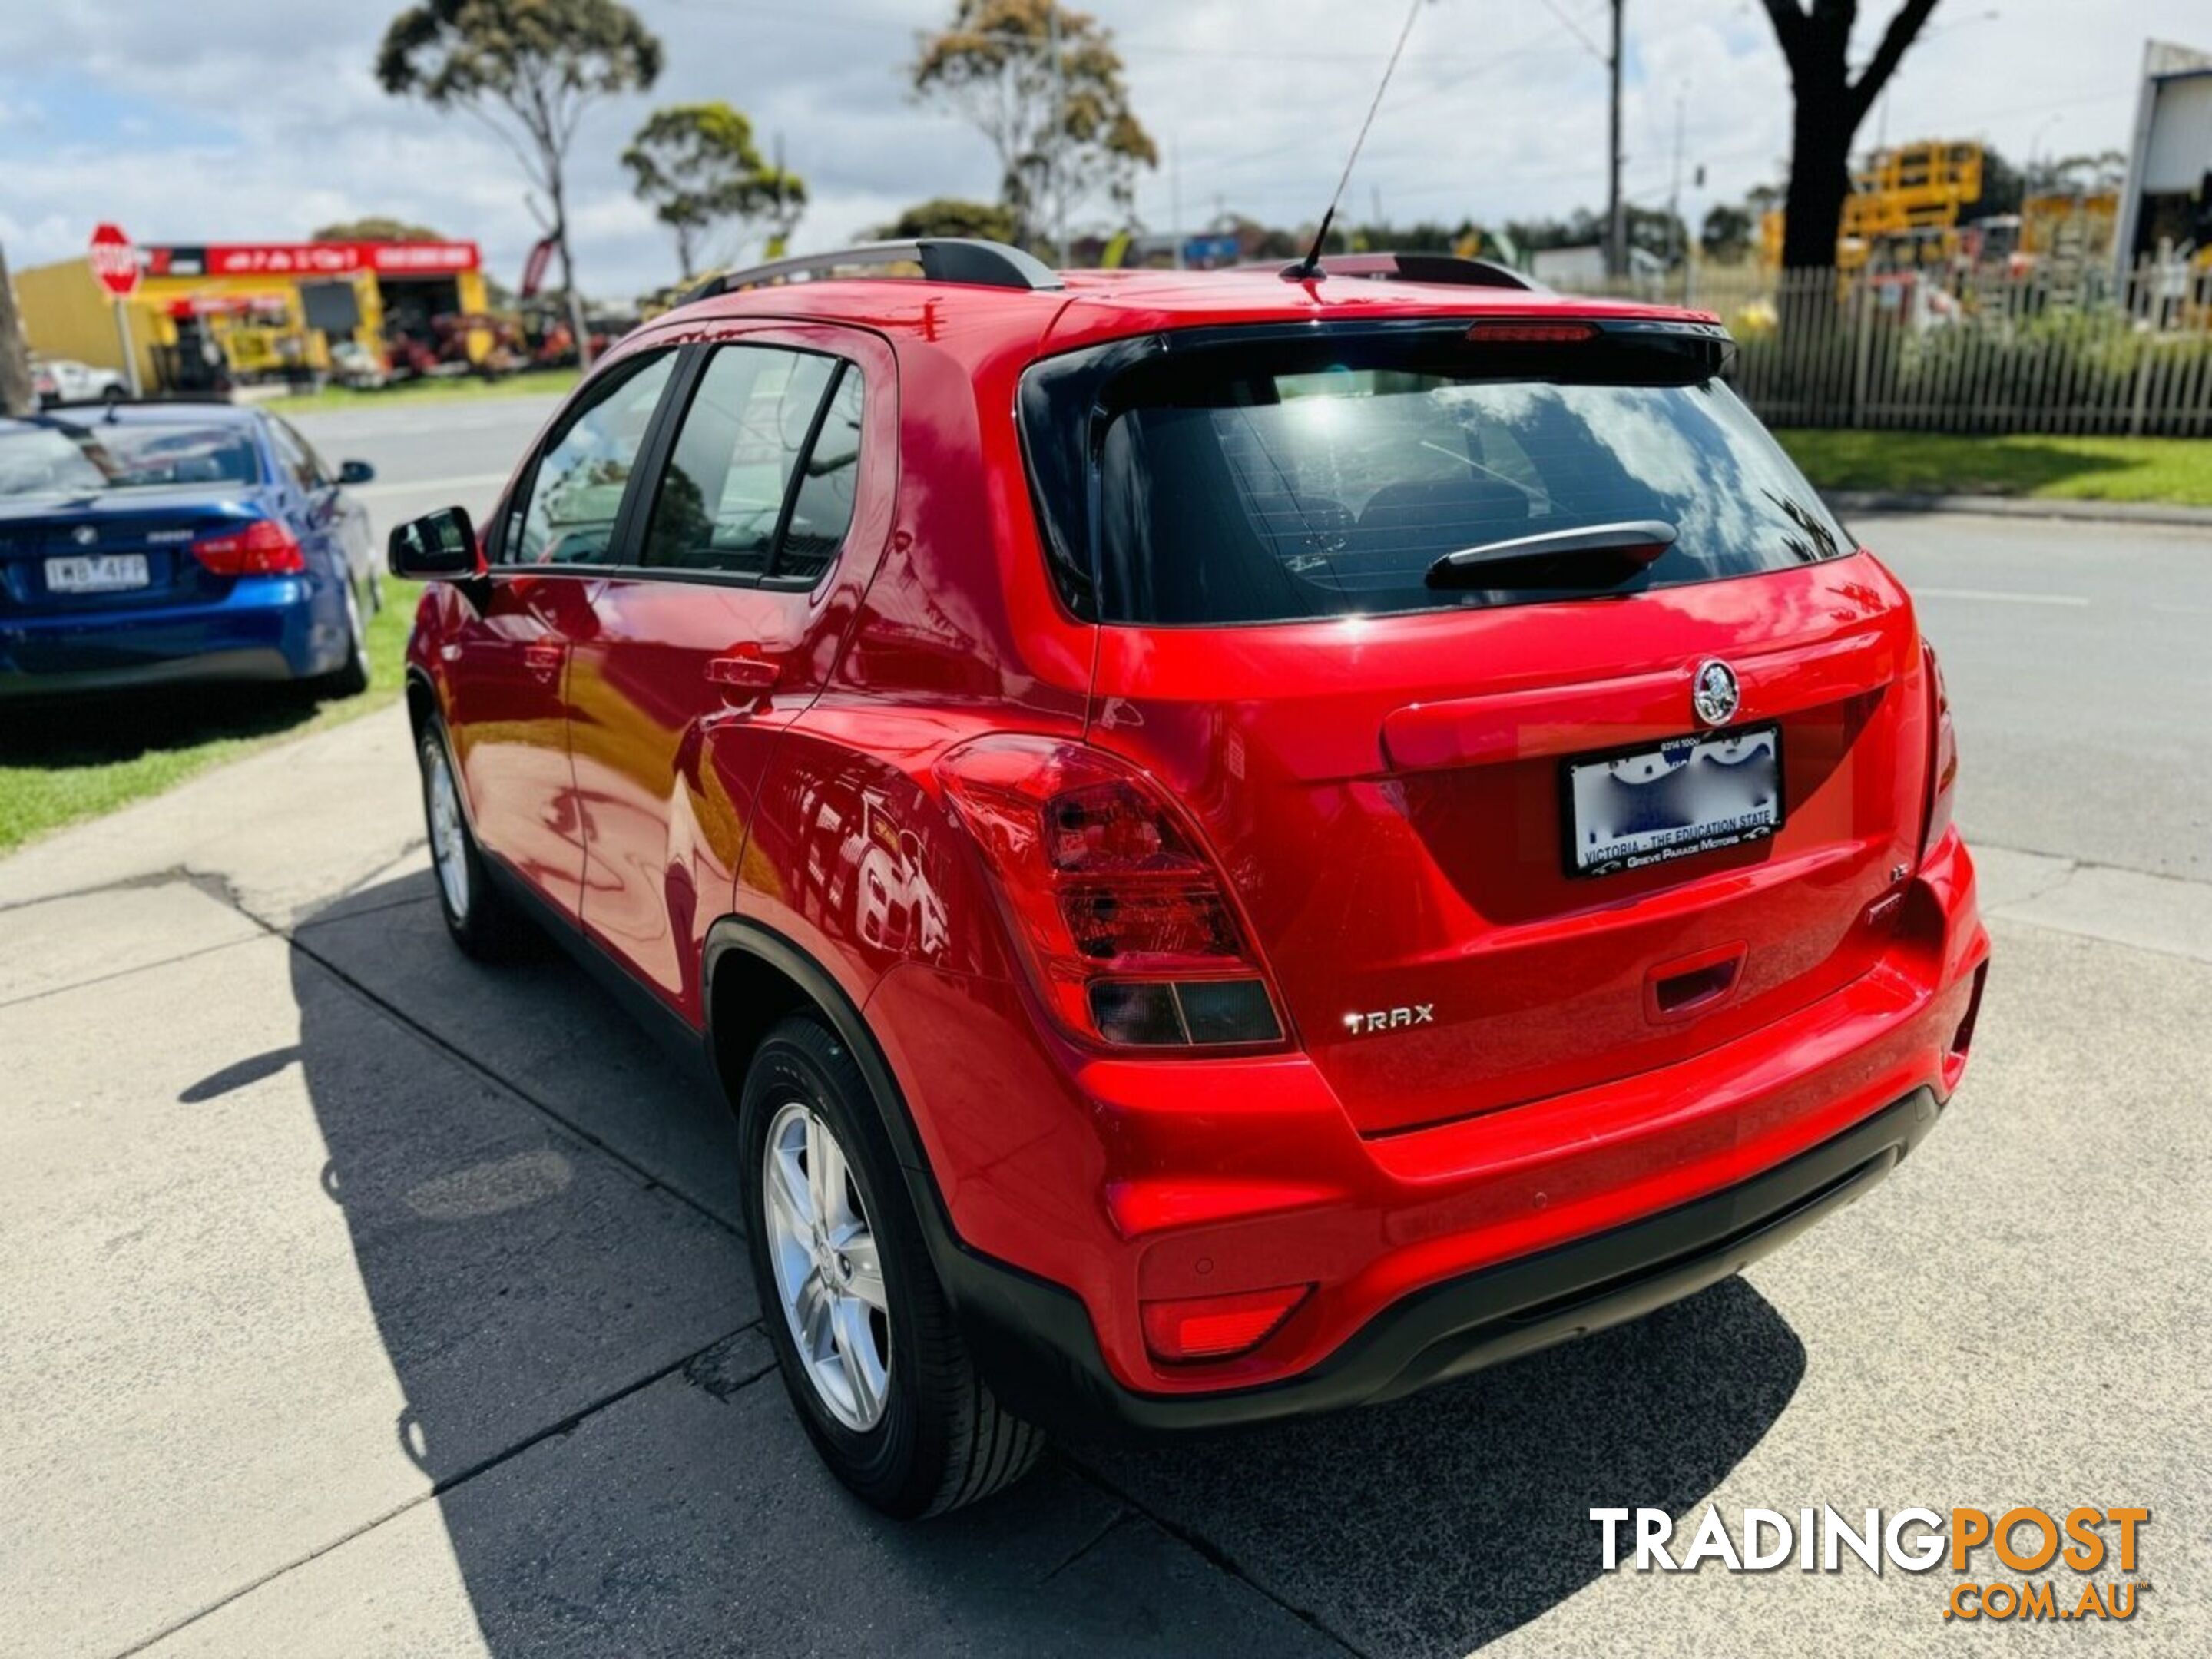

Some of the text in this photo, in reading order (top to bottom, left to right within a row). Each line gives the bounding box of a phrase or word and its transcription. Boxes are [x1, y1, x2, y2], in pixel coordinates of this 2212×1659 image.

[91, 243, 136, 275] STOP
[1585, 841, 1639, 864] VICTORIA
[1651, 833, 1672, 846] THE
[1675, 817, 1737, 842] EDUCATION
[1740, 810, 1770, 828] STATE
[1343, 1003, 1434, 1035] TRAX
